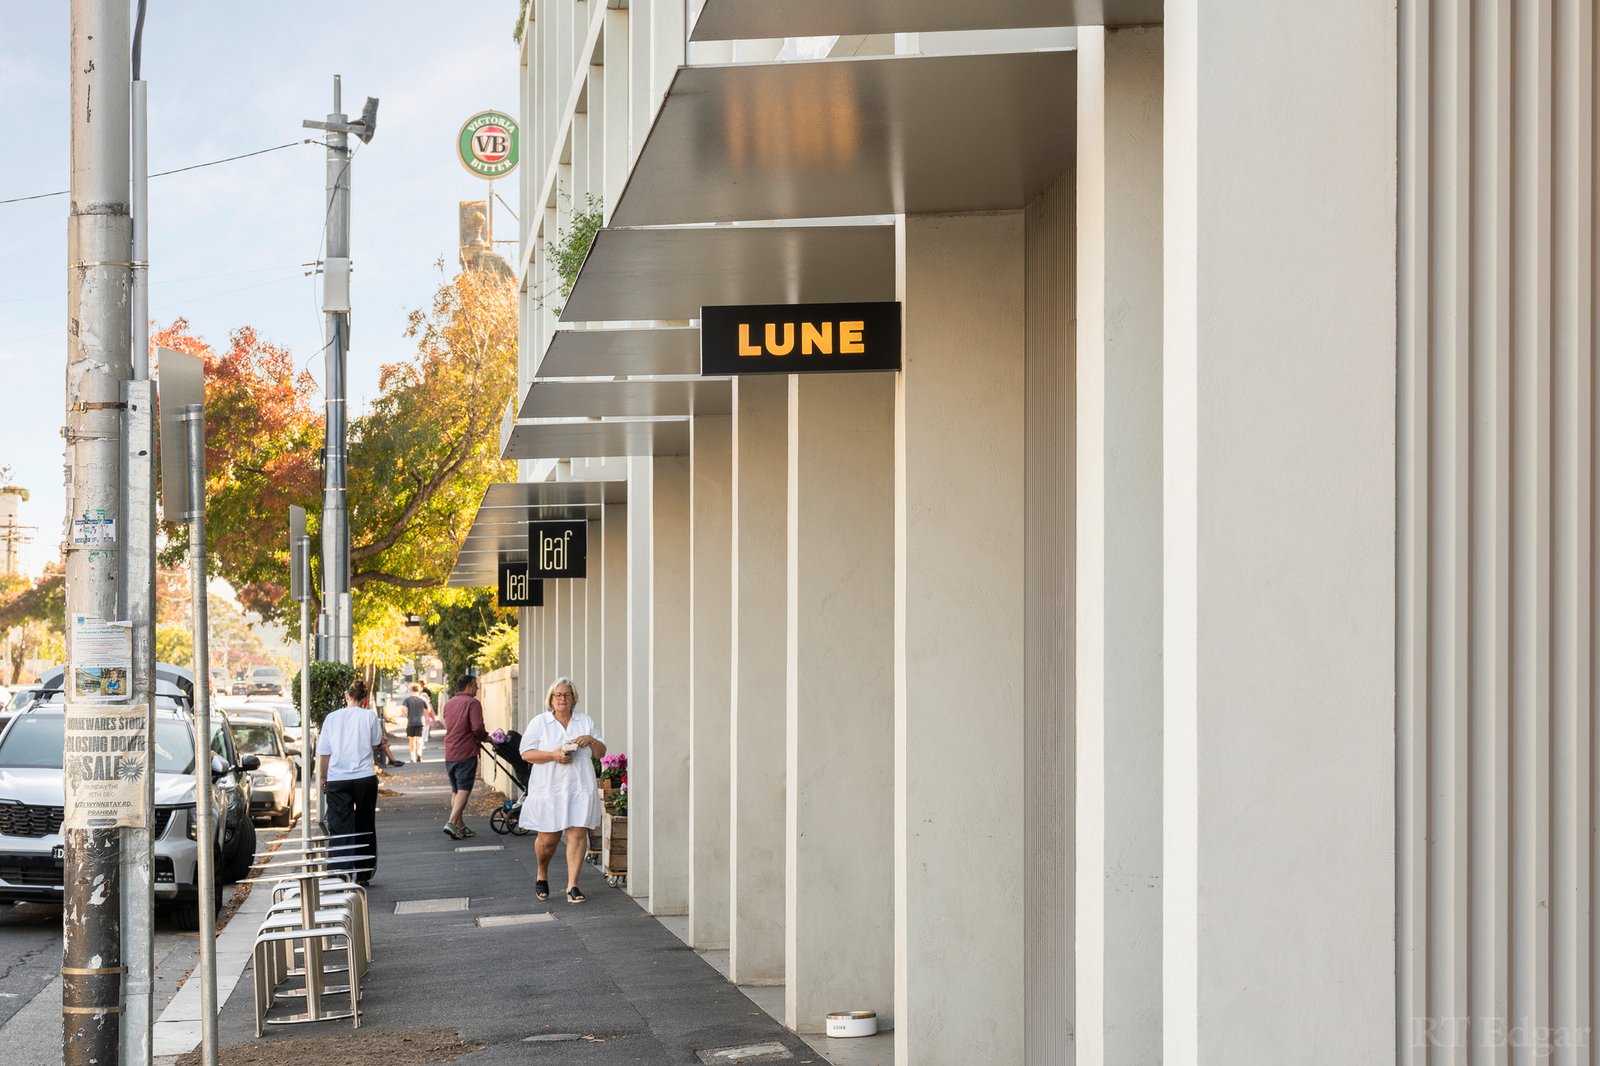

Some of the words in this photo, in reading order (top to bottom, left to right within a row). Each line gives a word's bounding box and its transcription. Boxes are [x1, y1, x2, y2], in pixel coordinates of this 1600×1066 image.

[468, 117, 515, 133] VICTORIA
[476, 135, 506, 153] VB
[470, 158, 512, 172] BITTER
[738, 320, 865, 357] LUNE
[539, 529, 573, 570] leaf
[119, 716, 145, 730] STORE
[67, 736, 107, 753] CLOSING
[111, 735, 145, 752] DOWN
[82, 755, 122, 781] SALE
